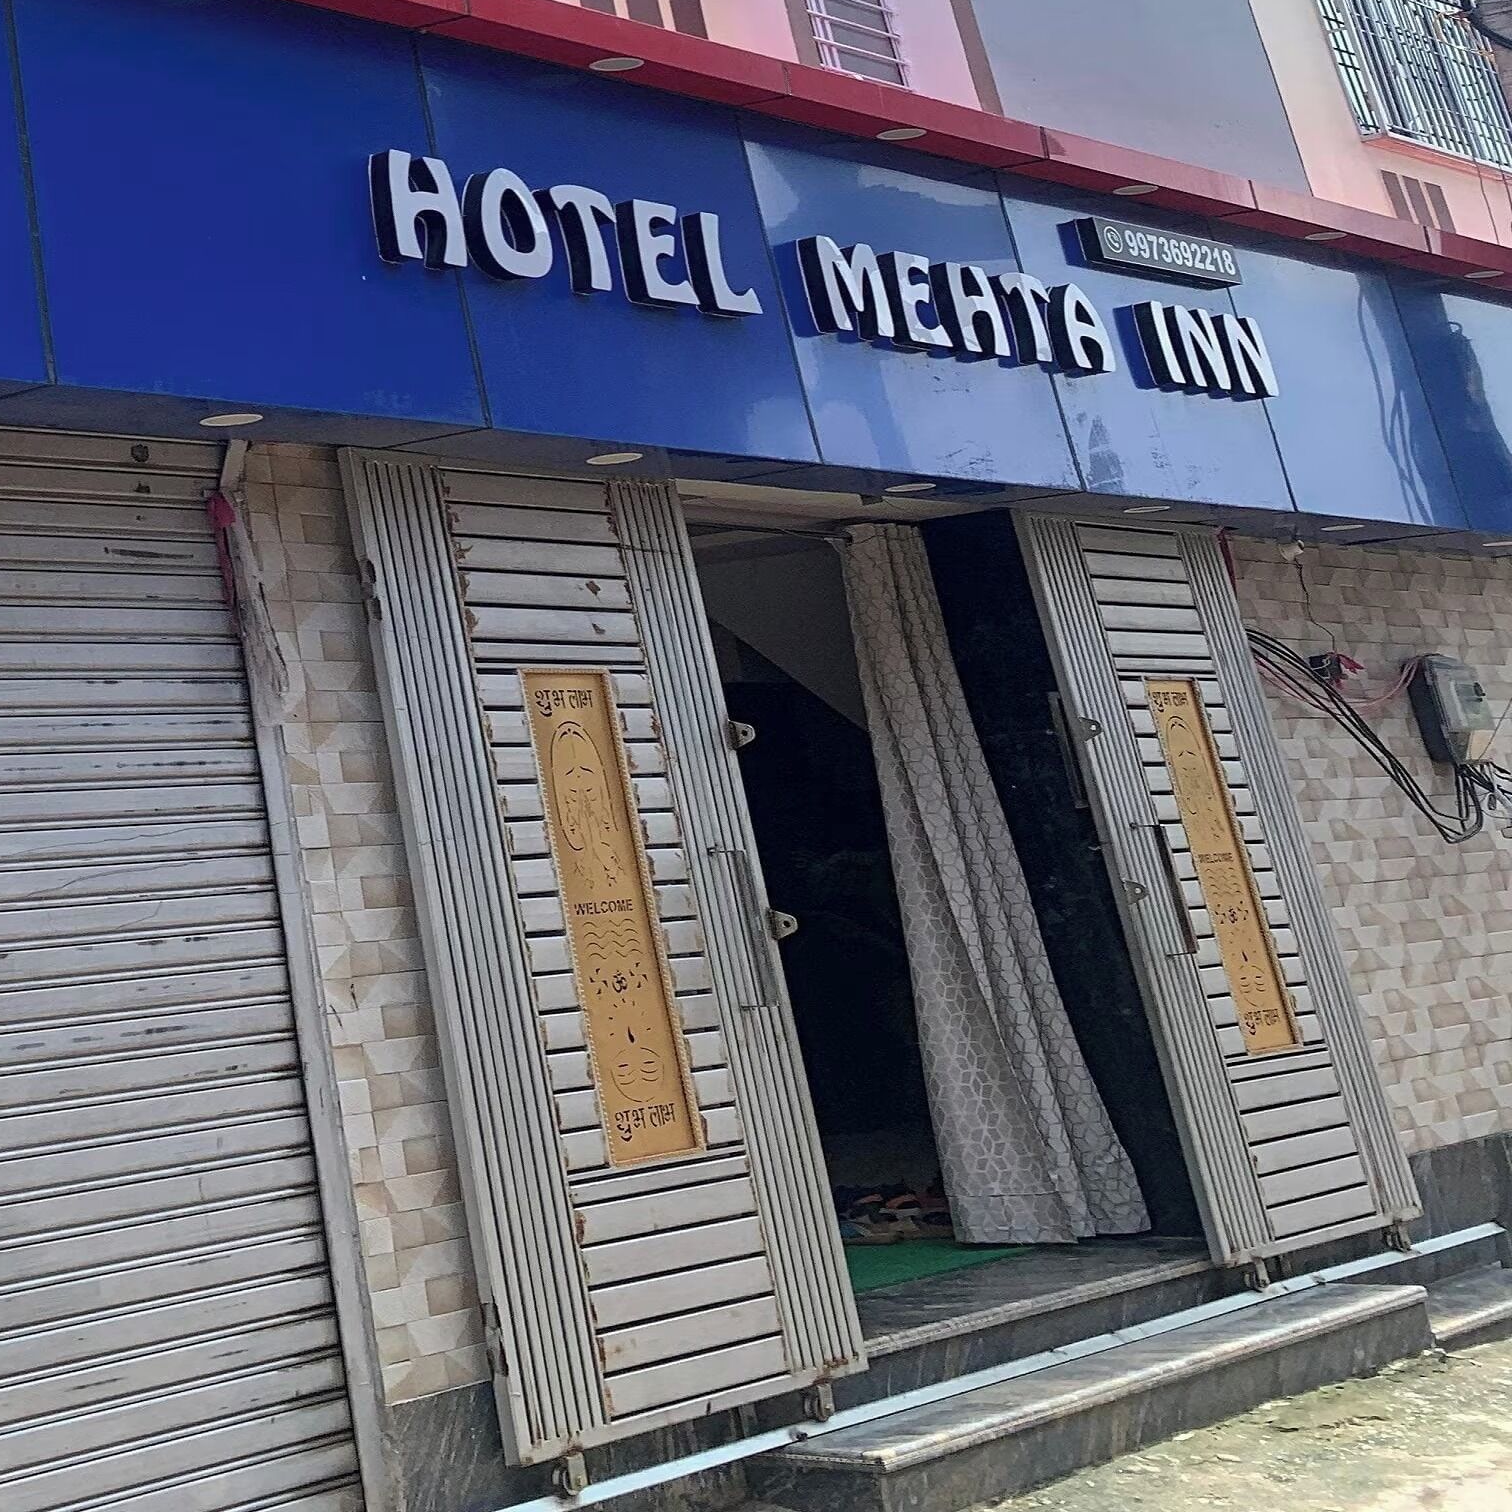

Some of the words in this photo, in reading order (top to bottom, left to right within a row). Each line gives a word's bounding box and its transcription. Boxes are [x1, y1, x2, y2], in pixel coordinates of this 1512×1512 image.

[369, 148, 764, 317] HOTEL
[797, 235, 1117, 373] MEHTA
[1133, 300, 1280, 398] INN
[1123, 230, 1237, 276] 9973692218
[534, 689, 566, 718] शुभ
[567, 689, 593, 710] लाभ
[574, 899, 634, 916] WELCOME
[614, 1106, 647, 1143] शुभ
[647, 1102, 677, 1129] लाभ
